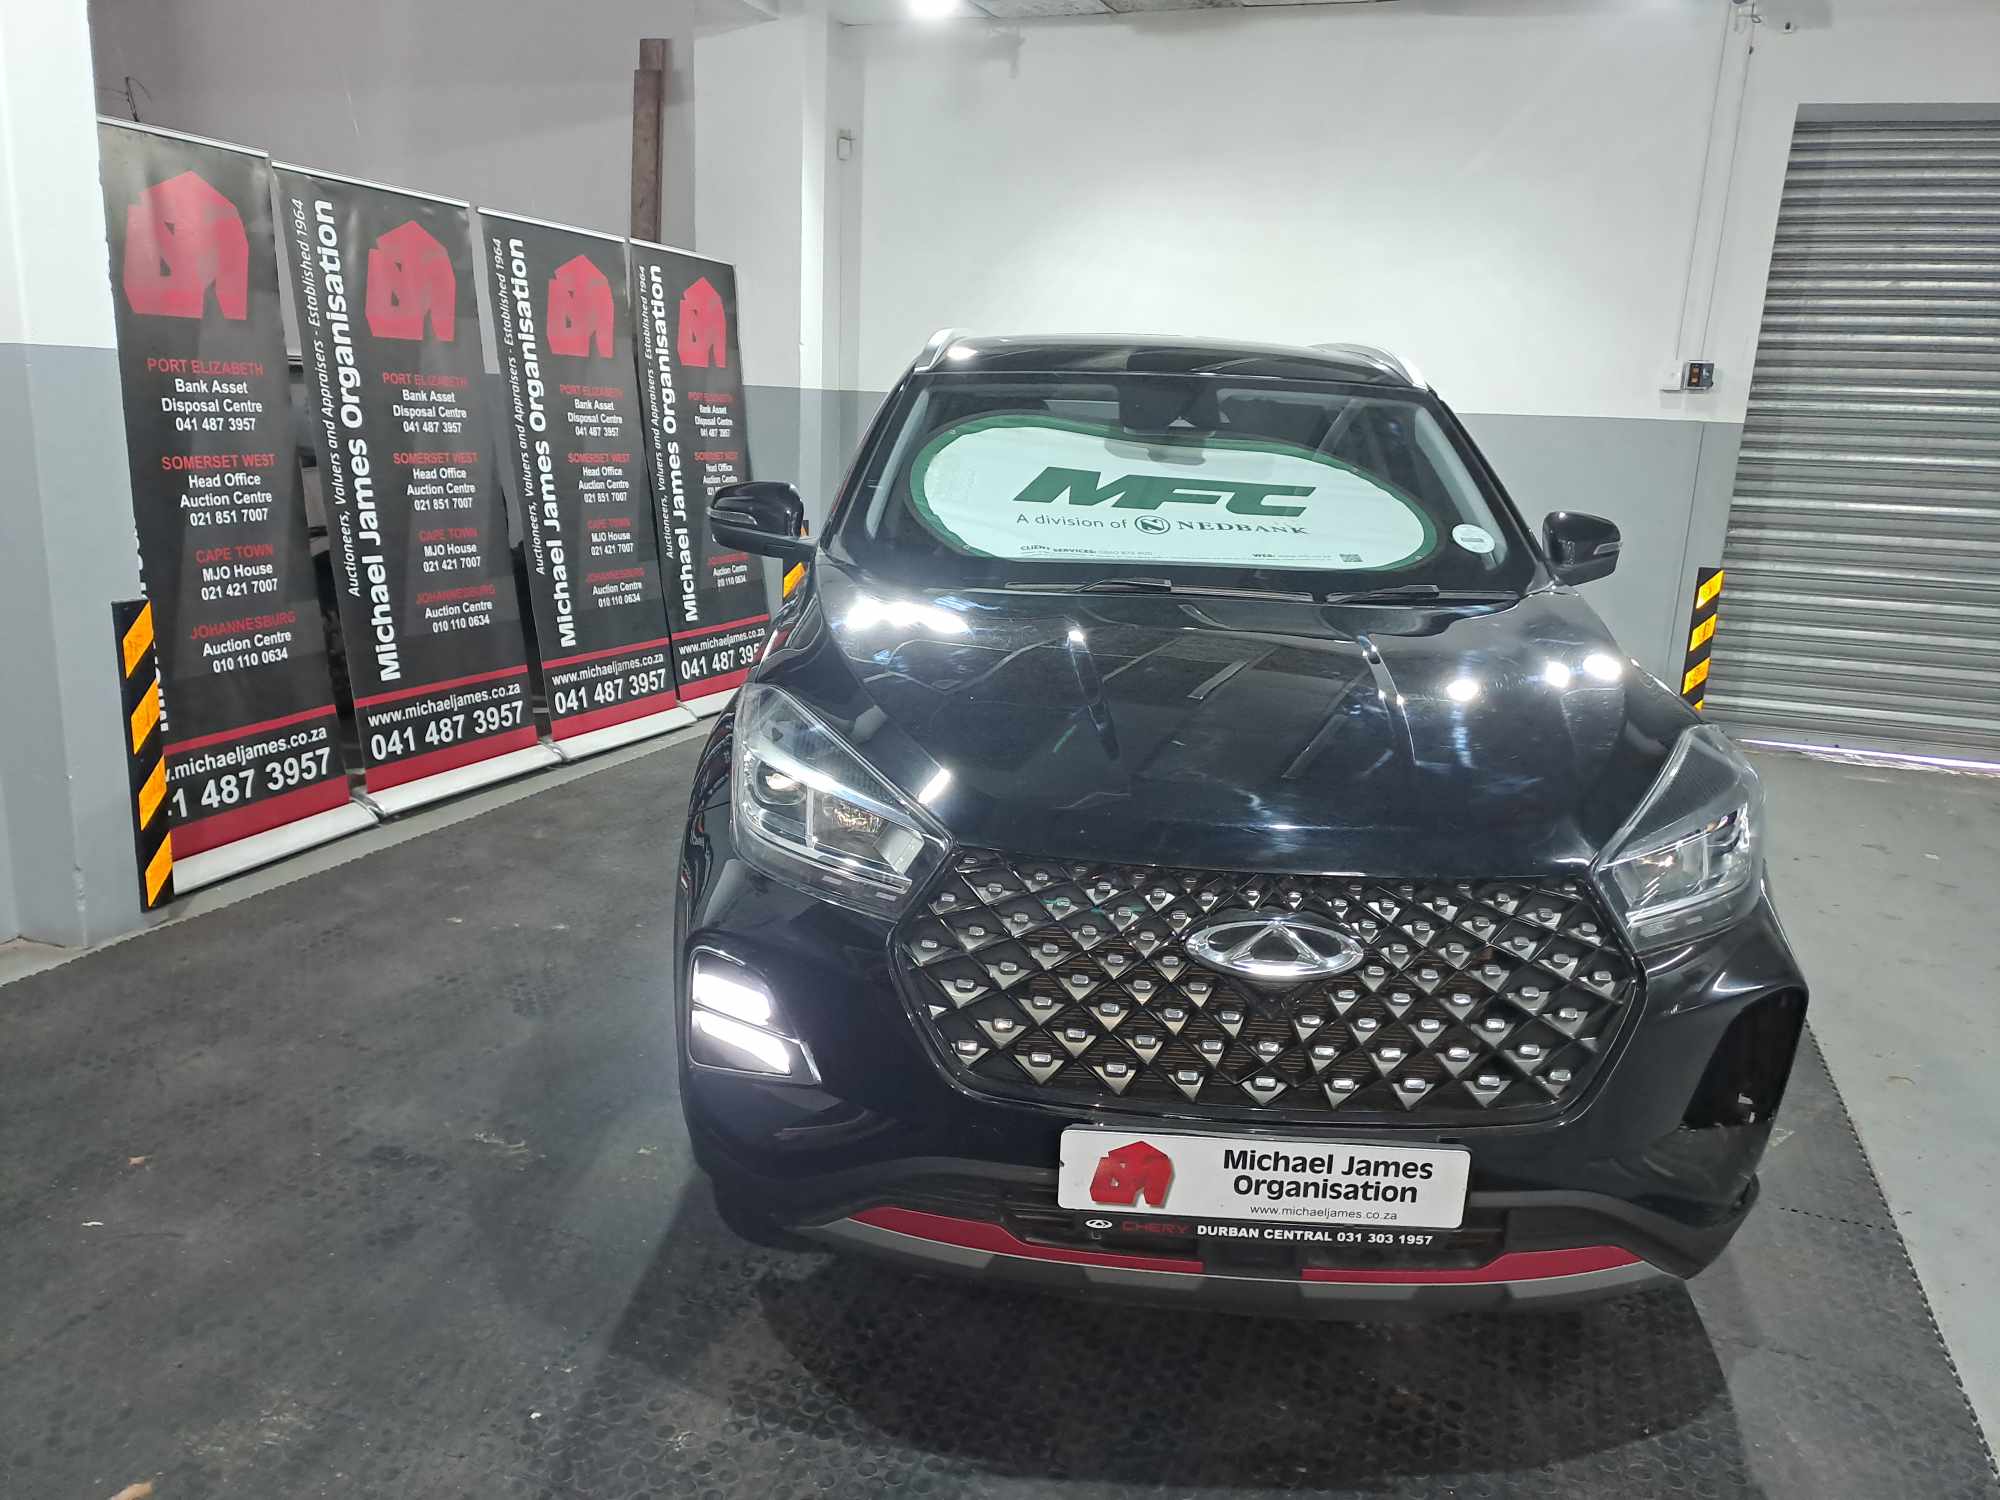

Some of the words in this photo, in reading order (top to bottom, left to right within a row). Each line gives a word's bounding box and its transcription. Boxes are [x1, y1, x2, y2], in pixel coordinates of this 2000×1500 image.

[291, 198, 304, 239] 1964
[492, 238, 506, 270] 1964
[298, 242, 321, 328] Established
[314, 199, 364, 429] organisation
[496, 274, 515, 347] Established
[508, 238, 547, 432] organisation
[650, 265, 677, 434] organisation
[146, 357, 187, 372] PORT
[191, 359, 264, 375] ELIZABETH
[312, 340, 334, 418] Appraisers
[175, 378, 208, 393] Bank
[212, 380, 248, 394] Asset
[402, 389, 428, 401] Bank
[430, 391, 456, 403] Asset
[508, 356, 526, 423] Appraisers
[161, 398, 220, 415] Disposal
[223, 400, 263, 412] Centre
[392, 405, 436, 419] Disposal
[438, 406, 467, 418] Centre
[175, 418, 198, 431] 041
[202, 418, 224, 431] 487
[228, 418, 256, 431] 3957
[322, 420, 339, 449] and
[403, 421, 419, 433] 041
[422, 421, 439, 433] 487
[442, 422, 462, 433] 3957
[515, 424, 528, 450] and
[161, 455, 238, 470] SOMERSET
[242, 453, 276, 467] WEST
[412, 468, 437, 480] Head
[439, 467, 467, 479] Office
[520, 452, 534, 497] Valuers
[188, 474, 221, 488] Head
[224, 473, 261, 486] Office
[330, 451, 346, 505] Valuers
[348, 438, 381, 546] James
[407, 483, 443, 496] Auction
[446, 482, 476, 494] Centre
[535, 440, 560, 532] James
[667, 441, 687, 521] James
[1012, 466, 1316, 518] MFC
[180, 493, 230, 508] Auction
[233, 491, 272, 505] Centre
[414, 499, 431, 511] 021
[433, 498, 449, 510] 851
[452, 497, 473, 509] 7007
[190, 513, 212, 526] 021
[216, 511, 237, 524] 851
[241, 508, 268, 522] 7007
[1016, 513, 1029, 524] A
[1035, 514, 1104, 528] division
[1110, 519, 1128, 529] of
[1178, 520, 1310, 535] NEDBANK
[424, 544, 445, 557] MJO
[447, 543, 477, 554] House
[527, 501, 545, 575] Auctioneers,
[196, 547, 231, 563] CAPE
[238, 544, 273, 558] TOWN
[338, 510, 360, 597] Auctioneers,
[423, 561, 440, 573] 021
[442, 558, 458, 570] 421
[460, 556, 481, 568] 7007
[202, 567, 231, 582] MJO
[234, 564, 273, 578] House
[674, 528, 699, 622] Michael
[201, 586, 222, 600] 021
[226, 583, 247, 597] 421
[252, 578, 278, 593] 7007
[546, 539, 577, 648] Michael
[362, 555, 401, 682] Michael
[425, 604, 460, 619] Auction
[462, 601, 493, 613] Centre
[432, 621, 449, 633] 010
[450, 618, 466, 630] 110
[468, 614, 490, 627] 0634
[203, 637, 251, 656] Auction
[254, 631, 292, 647] Centre
[678, 627, 766, 655] www.michaeljames.co.za
[212, 659, 234, 673] 010
[237, 653, 258, 669] 110
[262, 648, 288, 663] 0634
[551, 652, 664, 686] www.michaeljames.co.za
[681, 656, 708, 679] 041
[711, 649, 735, 671] 487
[368, 682, 521, 727] www.michaeljames.co.za
[554, 688, 589, 714] 041
[593, 679, 623, 703] 487
[628, 669, 666, 696] 3957
[370, 727, 416, 761] 041
[424, 714, 465, 745] 487
[472, 700, 524, 734] 3957
[201, 769, 255, 808] 487
[265, 747, 331, 791] 3957
[1223, 1149, 1333, 1175] Michael
[1342, 1155, 1433, 1180] James
[1233, 1175, 1418, 1204] Organisation
[1121, 1220, 1191, 1234] CHERY
[1197, 1225, 1259, 1239] DURBAN
[1263, 1228, 1333, 1242] CENTRAL
[1337, 1231, 1362, 1243] 031
[1368, 1233, 1394, 1244] 303
[1398, 1234, 1433, 1246] 1957
